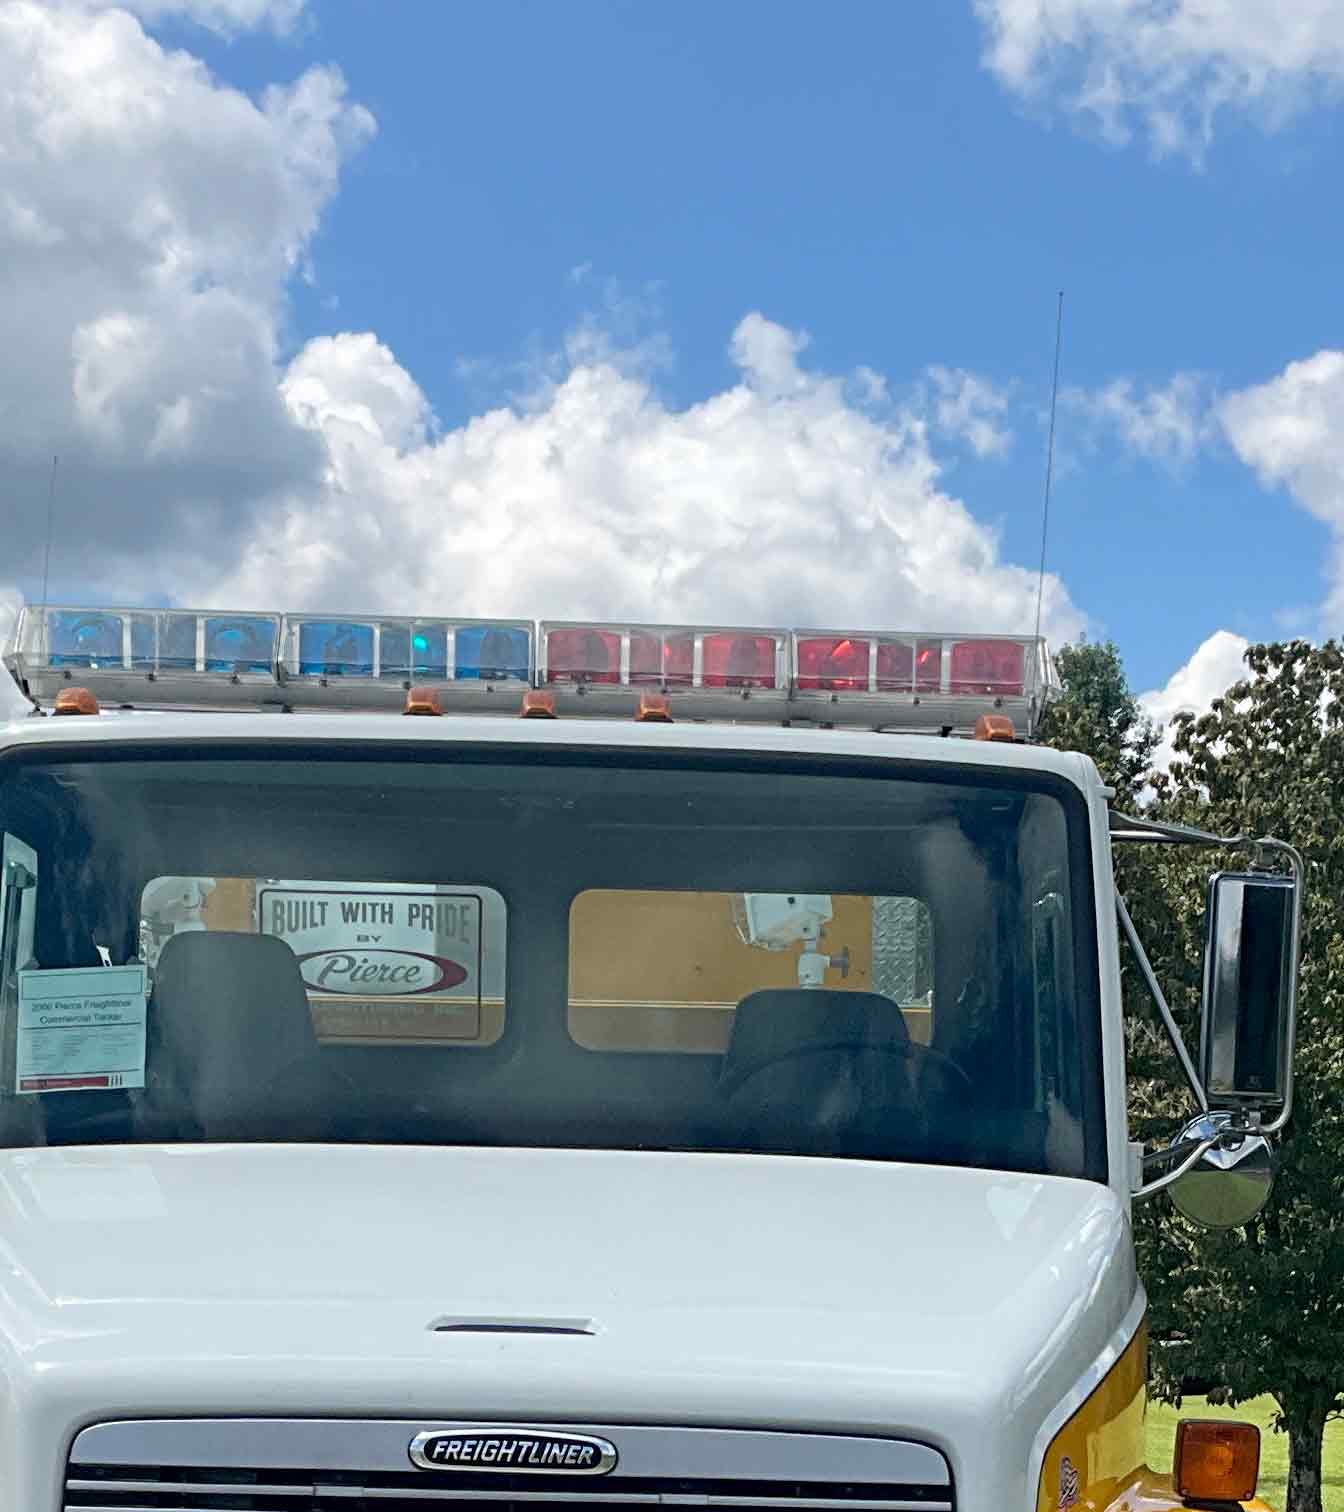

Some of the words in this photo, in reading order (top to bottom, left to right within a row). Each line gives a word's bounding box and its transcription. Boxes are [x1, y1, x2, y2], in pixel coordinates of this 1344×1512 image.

[272, 899, 329, 935] BUILT
[341, 902, 393, 925] WITH
[408, 903, 471, 944] PRIDE
[356, 934, 382, 943] BY
[317, 954, 423, 985] Pierce
[431, 1440, 594, 1464] FREIGHTLINER
